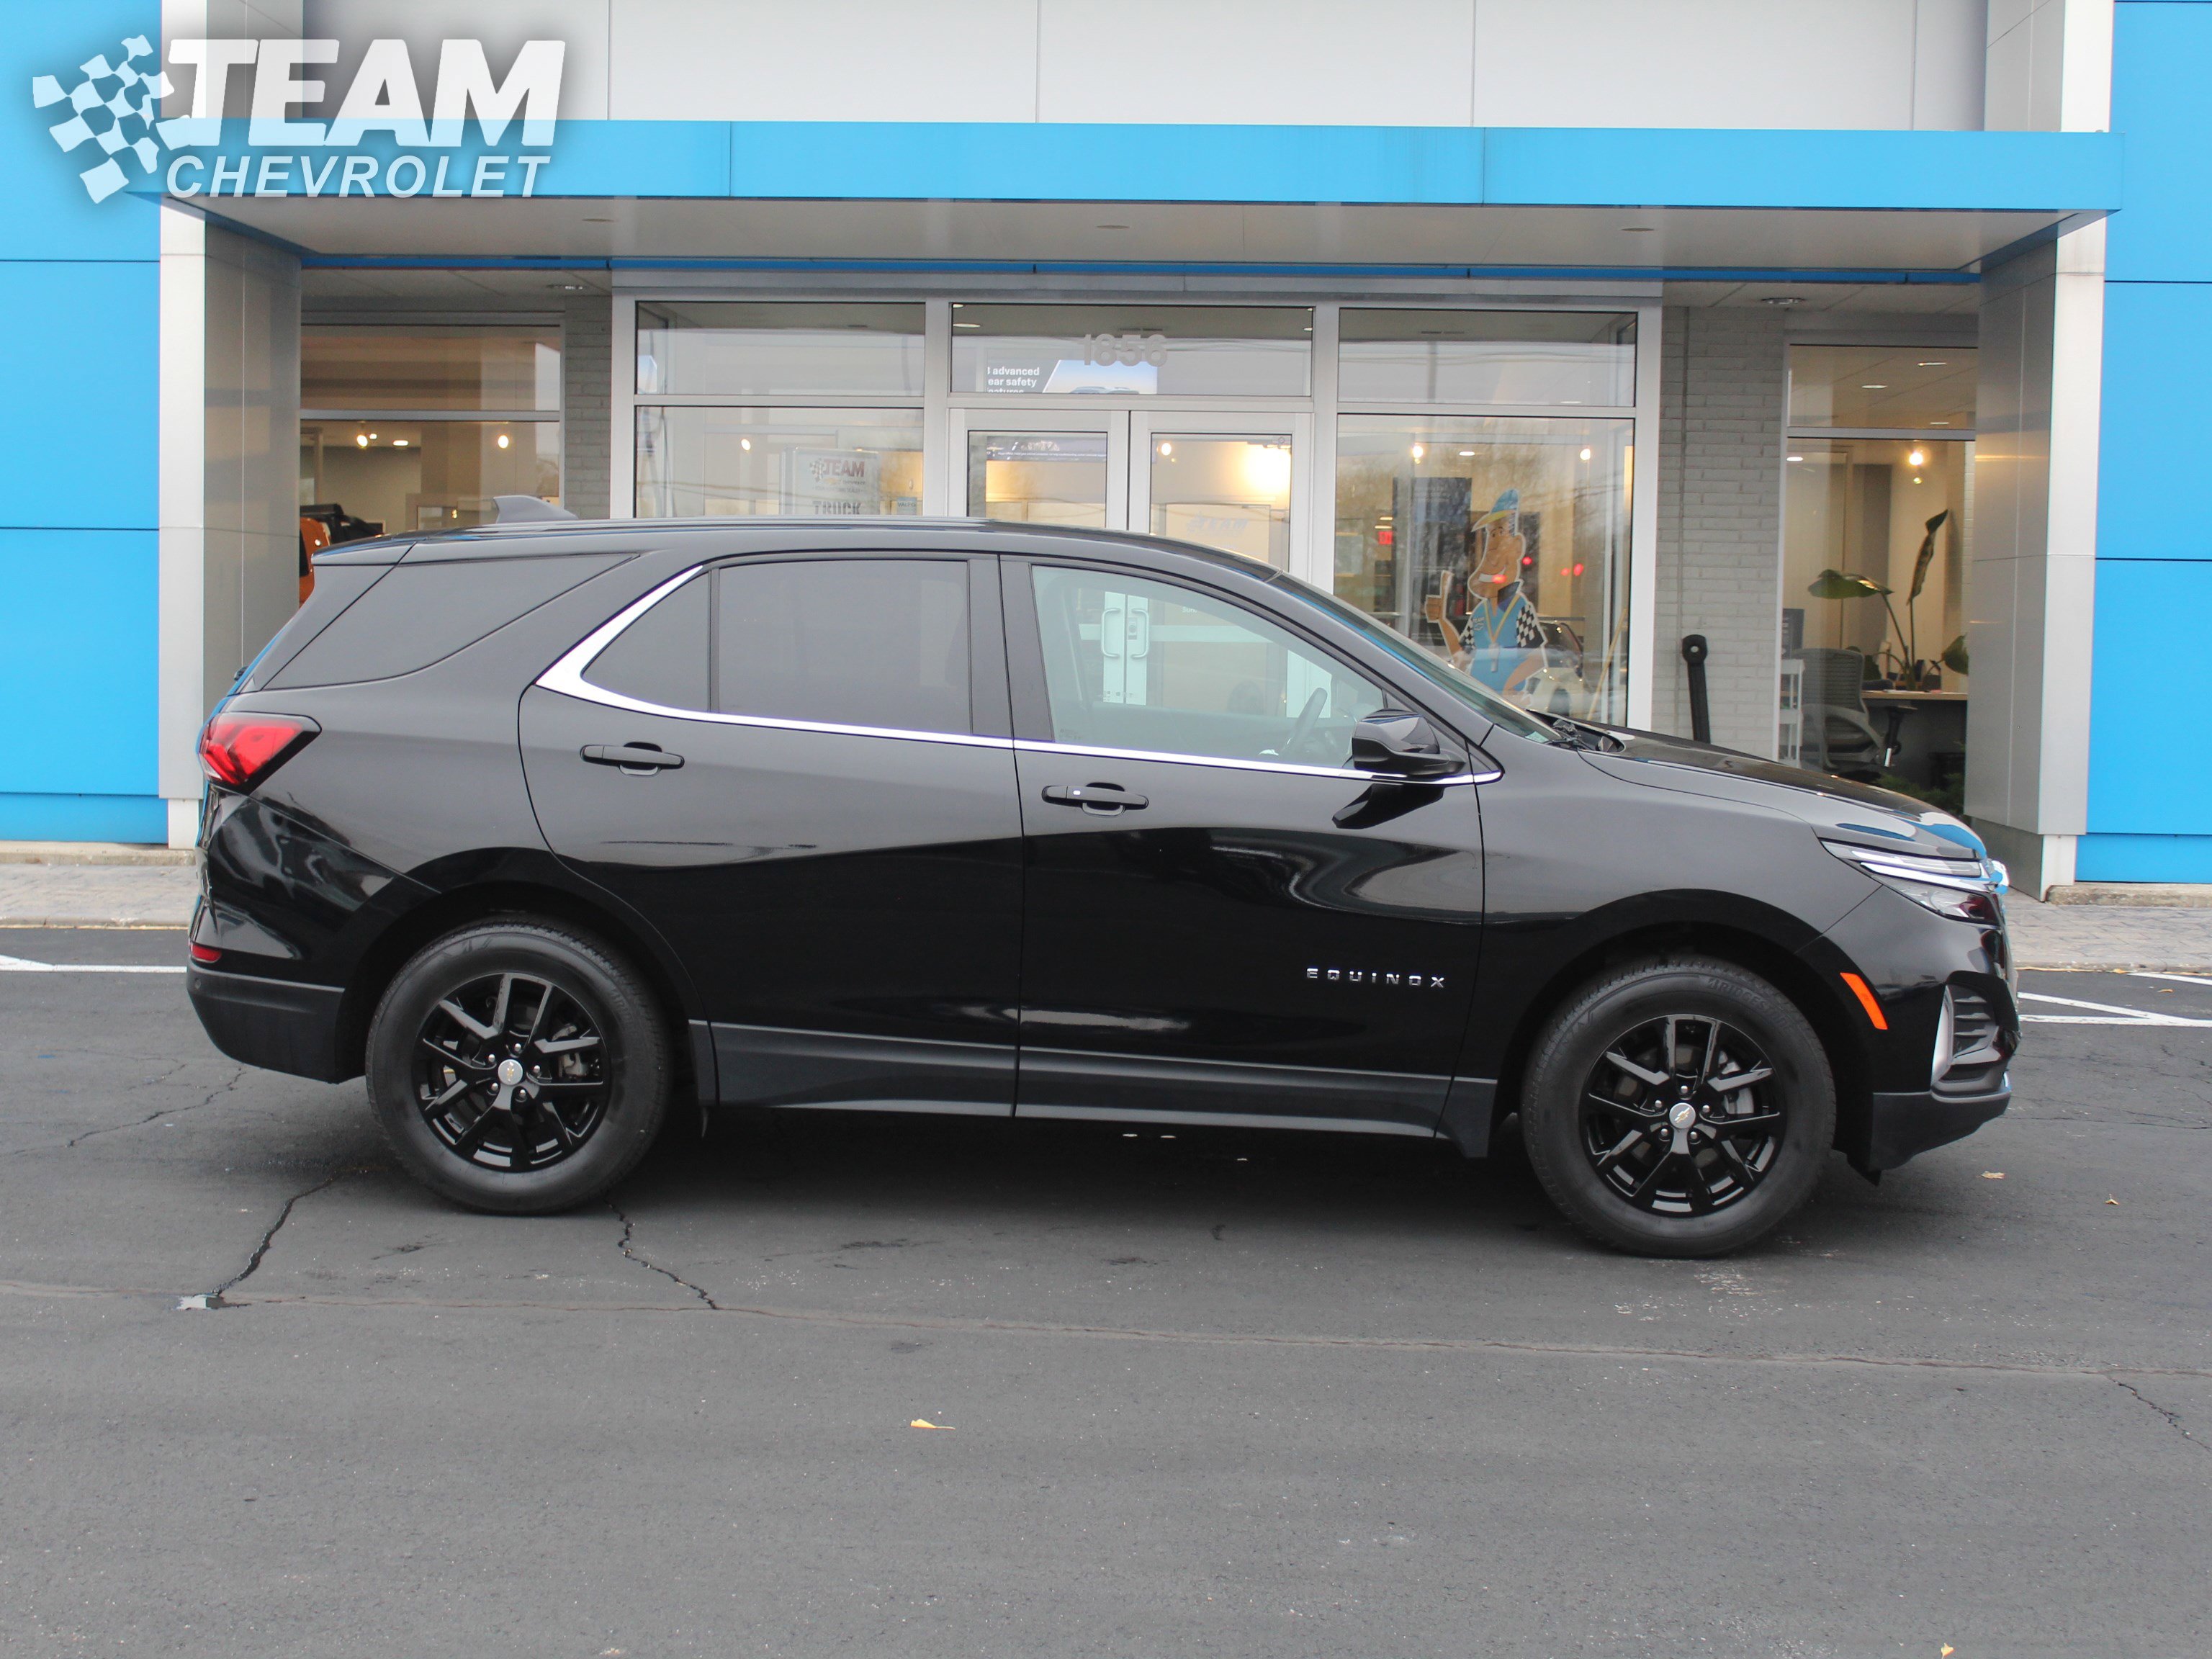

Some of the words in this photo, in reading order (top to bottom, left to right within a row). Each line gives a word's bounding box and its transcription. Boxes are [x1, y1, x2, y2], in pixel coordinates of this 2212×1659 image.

[1078, 333, 1167, 367] 1856
[992, 367, 1040, 375] advanced
[1006, 377, 1037, 388] safety
[824, 459, 865, 477] TEAM
[1306, 968, 1445, 989] EQUINOX
